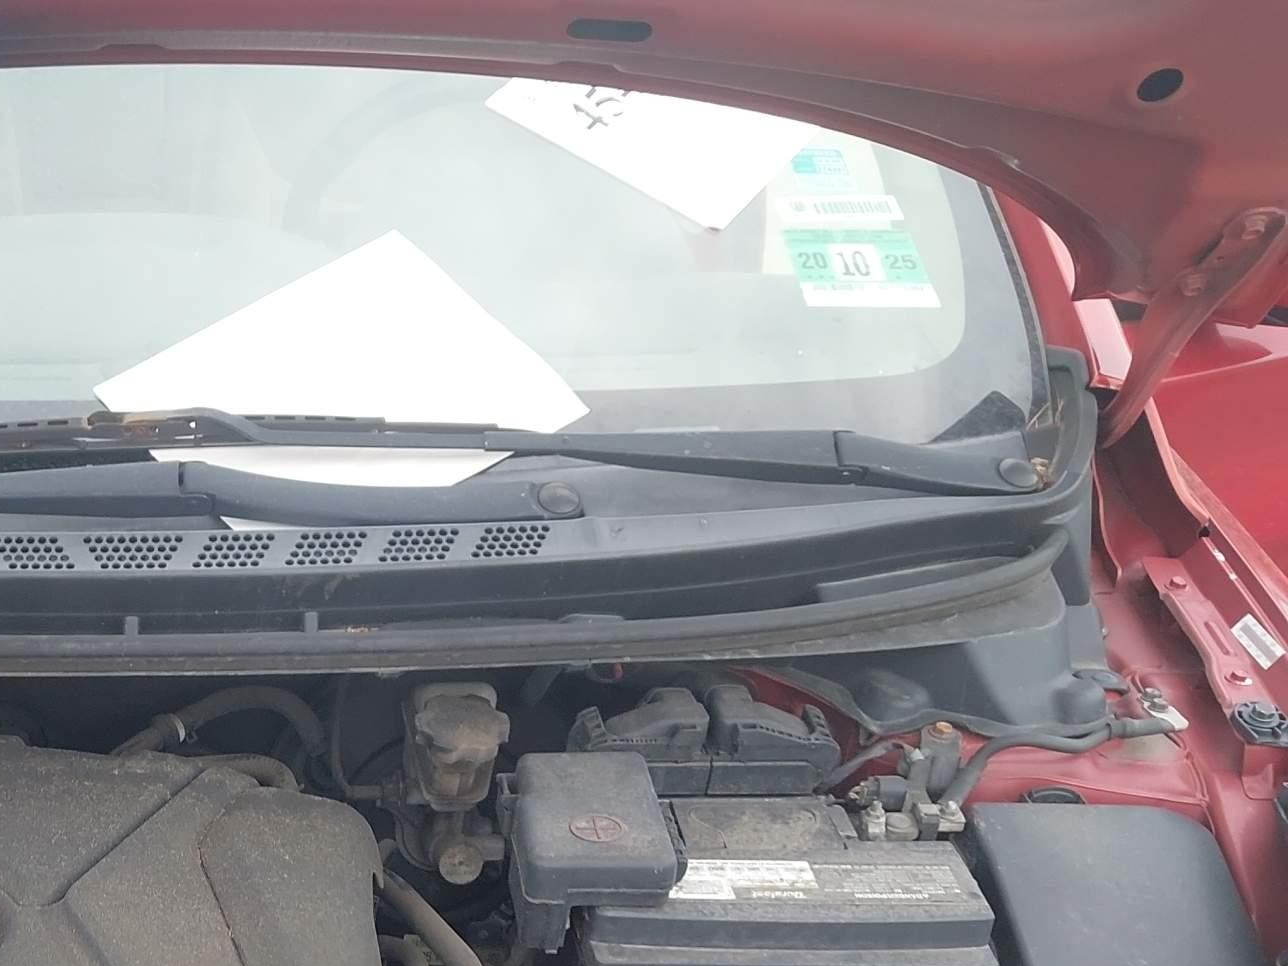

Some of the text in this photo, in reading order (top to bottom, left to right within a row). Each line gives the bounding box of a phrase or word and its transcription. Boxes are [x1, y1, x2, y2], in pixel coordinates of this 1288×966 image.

[798, 250, 917, 277] 20 10 25
